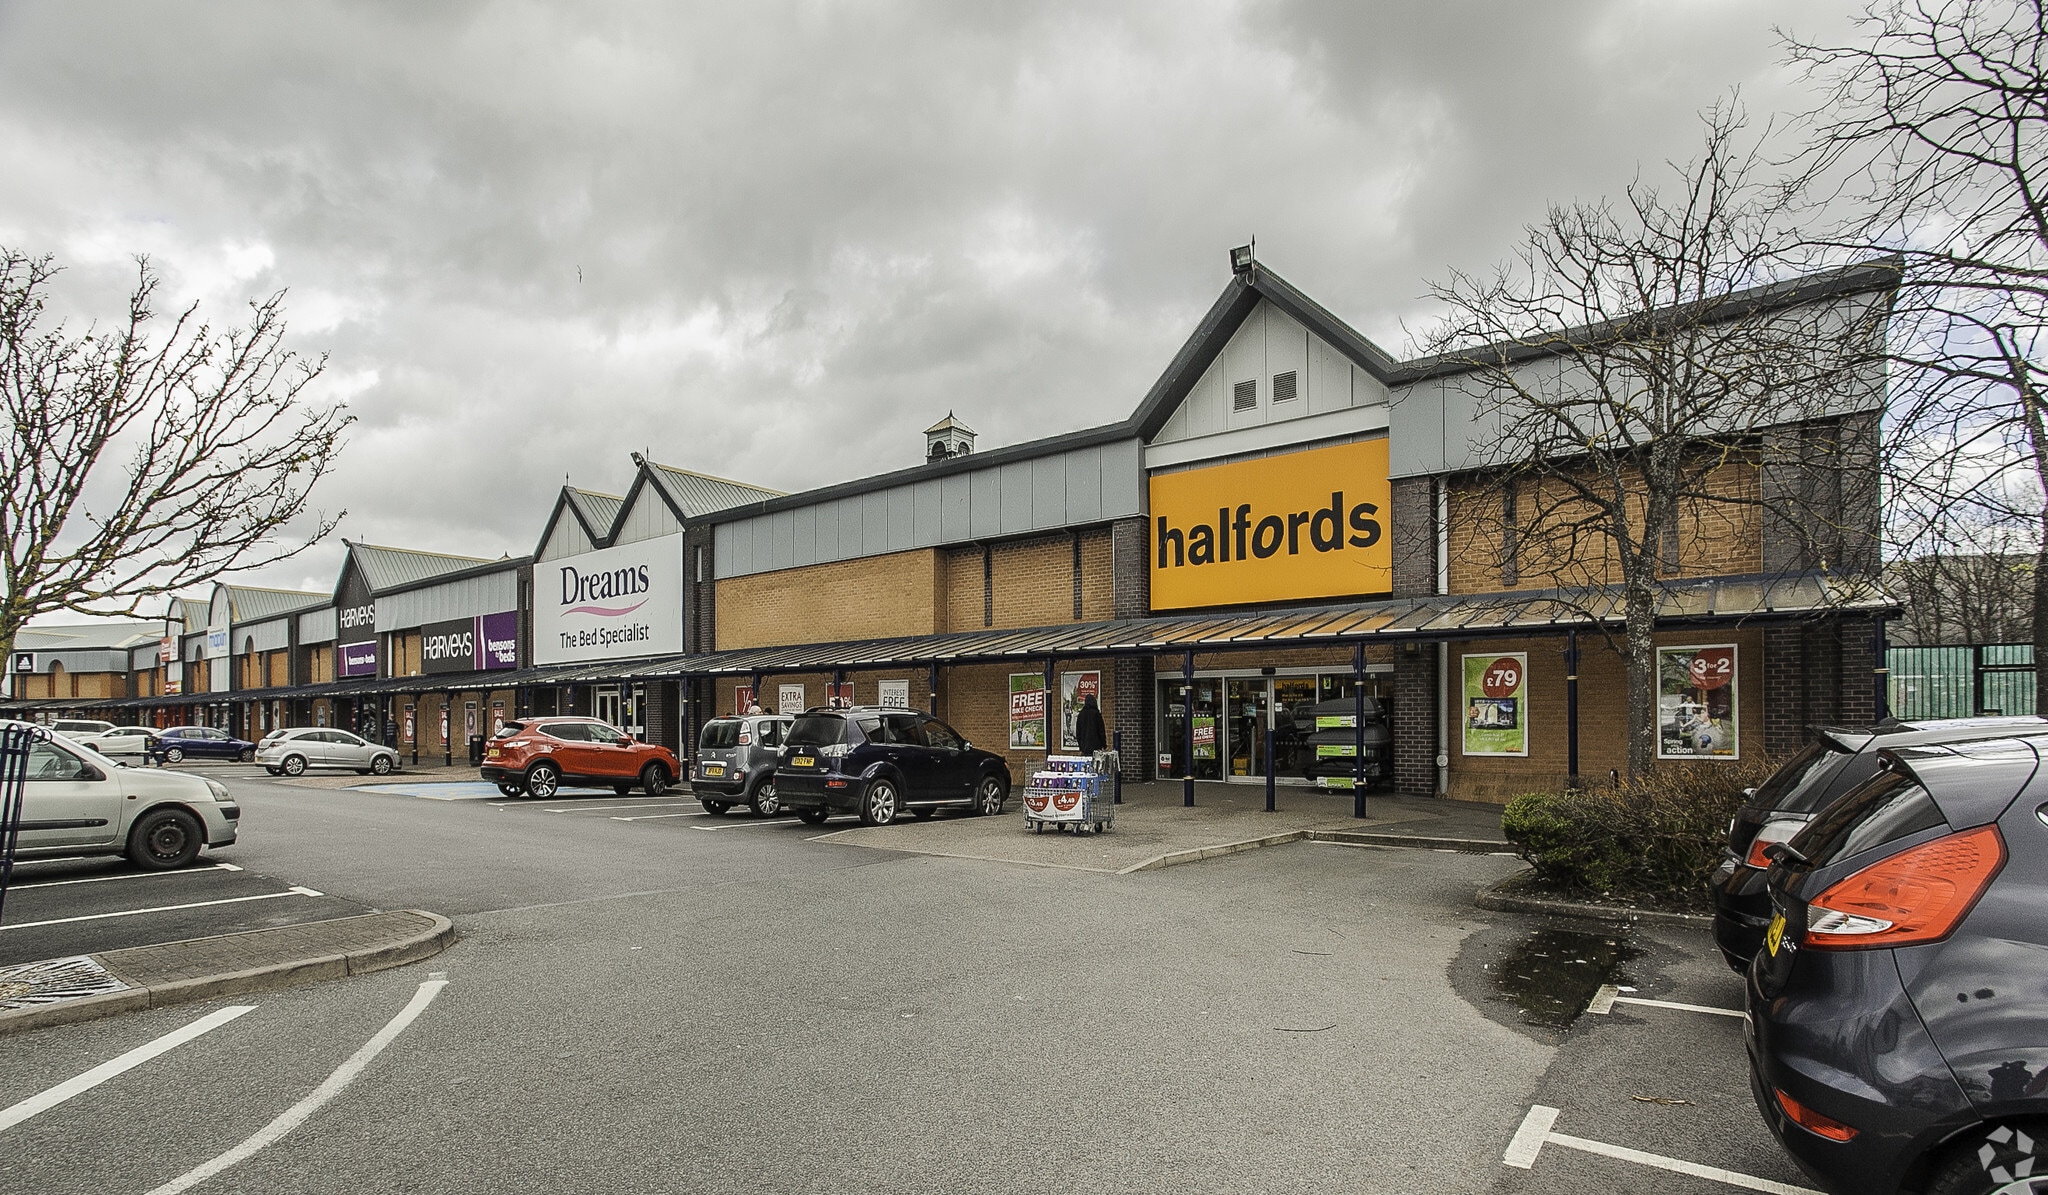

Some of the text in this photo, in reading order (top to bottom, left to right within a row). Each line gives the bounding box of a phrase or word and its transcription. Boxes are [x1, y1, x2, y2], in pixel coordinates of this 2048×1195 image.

[1157, 491, 1382, 569] halfords
[560, 564, 649, 605] Dreams
[560, 623, 649, 649] The Bed Specialist
[488, 638, 515, 651] bensons
[499, 650, 515, 662] beds
[1694, 659, 1707, 674] 3
[1717, 658, 1730, 673] 2
[1486, 669, 1517, 687] £79
[781, 691, 802, 701] EXTRA
[883, 688, 905, 696] INTEREST
[883, 696, 905, 707] FREE
[1012, 692, 1043, 708] FREE
[1025, 705, 1043, 713] CHECK
[1193, 726, 1214, 737] FREE
[1667, 745, 1693, 754] action
